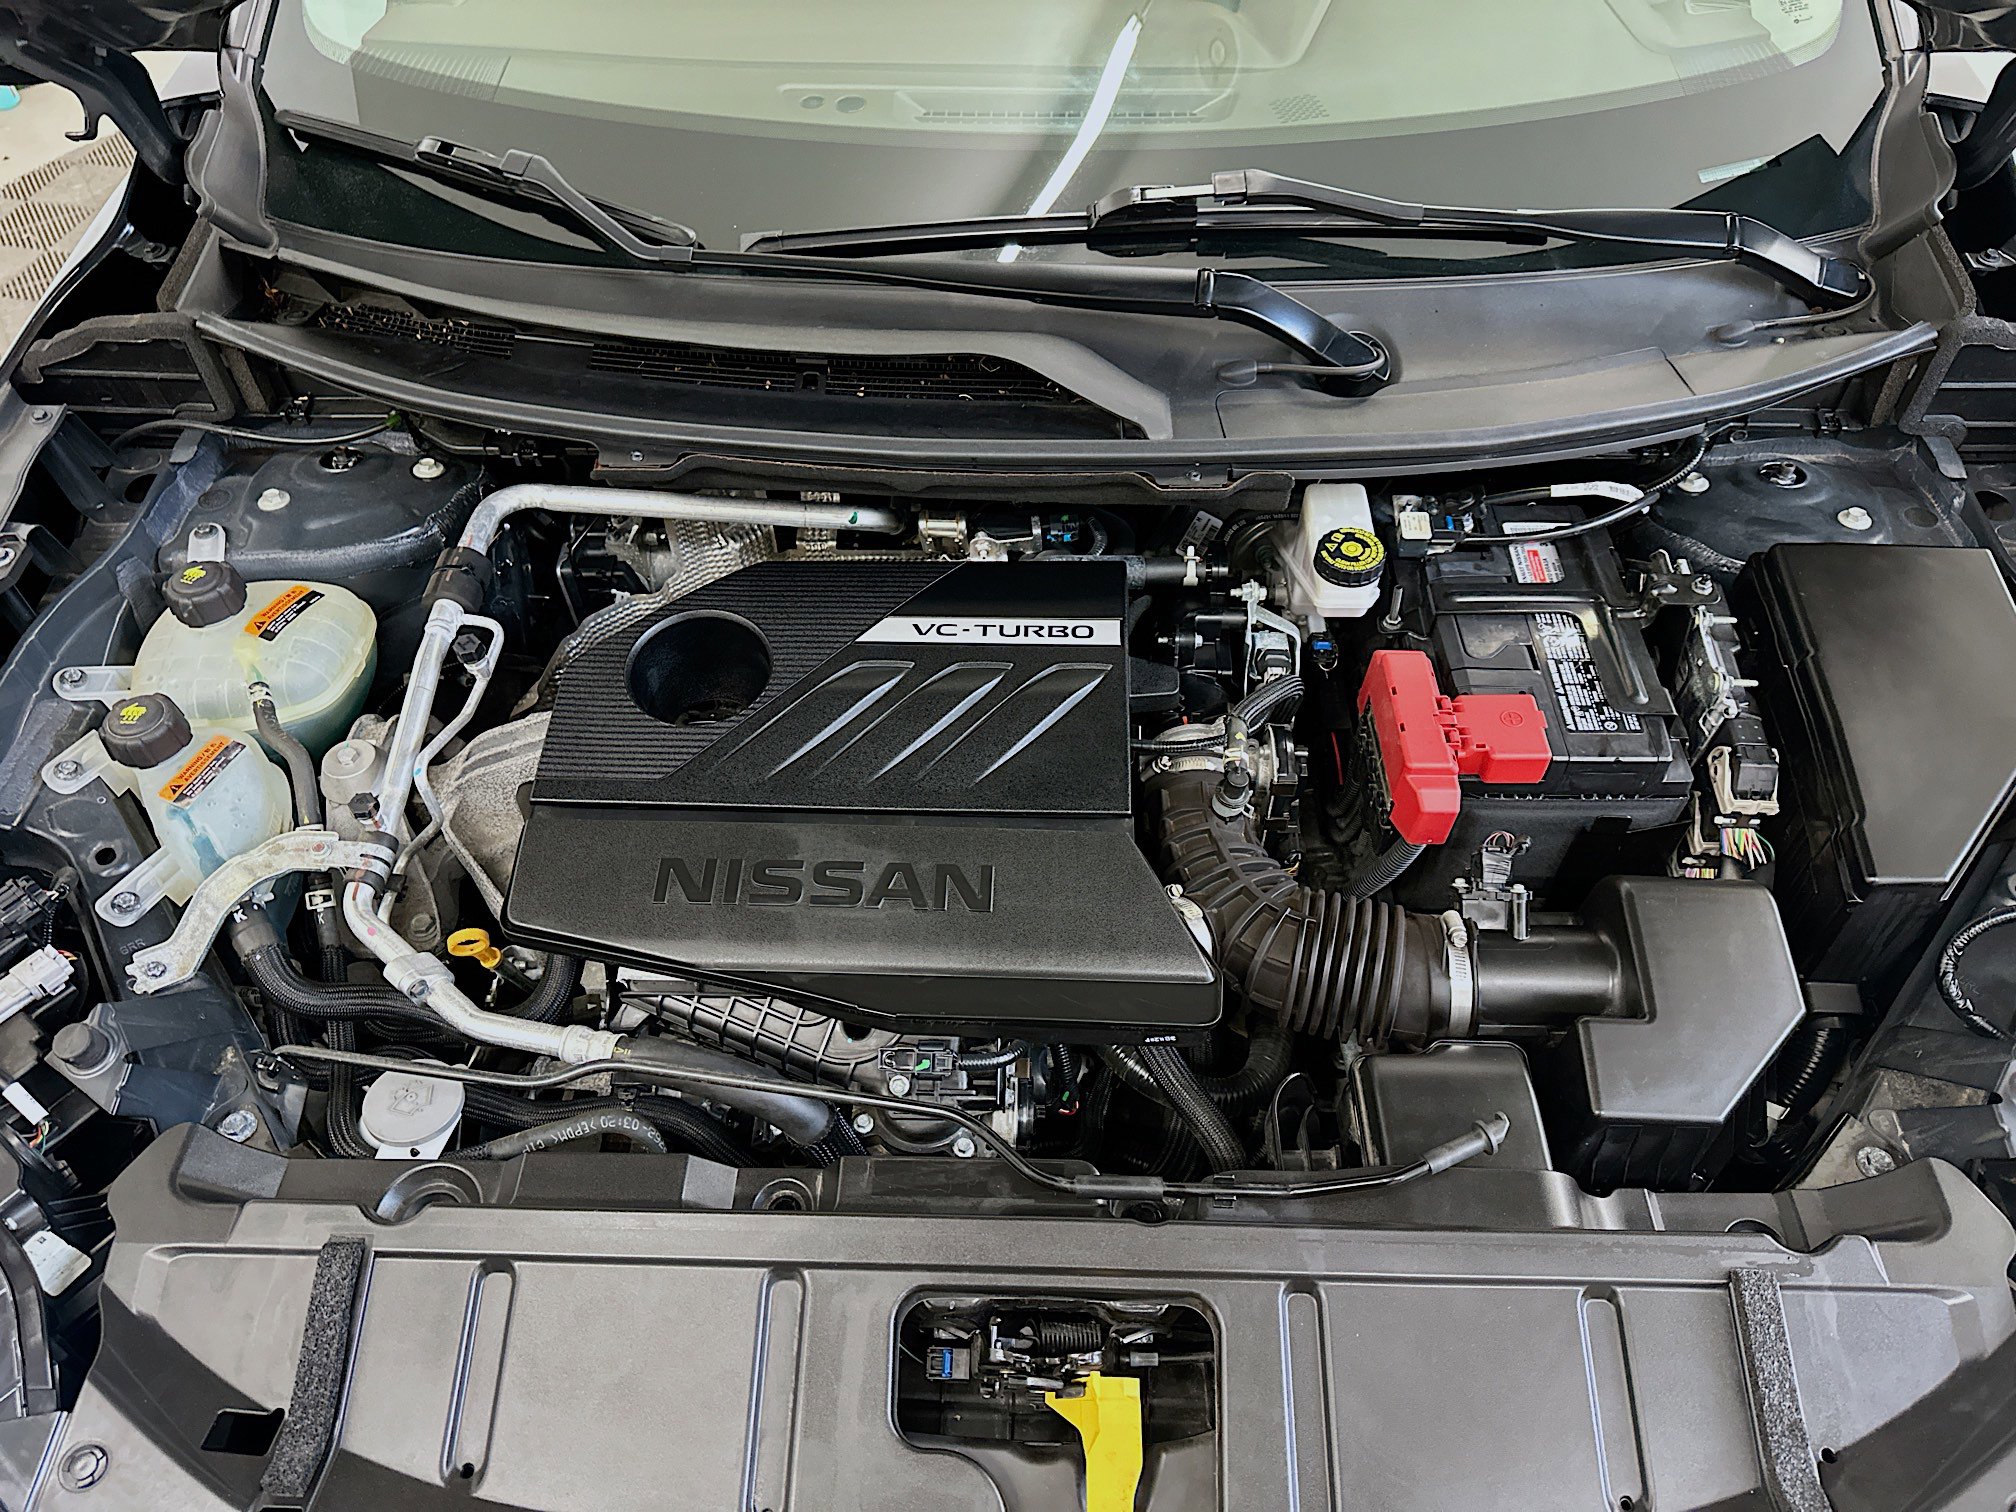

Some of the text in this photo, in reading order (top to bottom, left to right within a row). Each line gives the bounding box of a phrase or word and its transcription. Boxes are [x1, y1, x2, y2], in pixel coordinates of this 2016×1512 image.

[912, 623, 1095, 639] VC-TURBO
[177, 755, 204, 780] WARNING
[184, 741, 225, 782] AVERTISSEMENT
[652, 857, 995, 912] NISSAN
[233, 908, 248, 924] K
[317, 912, 325, 924] K
